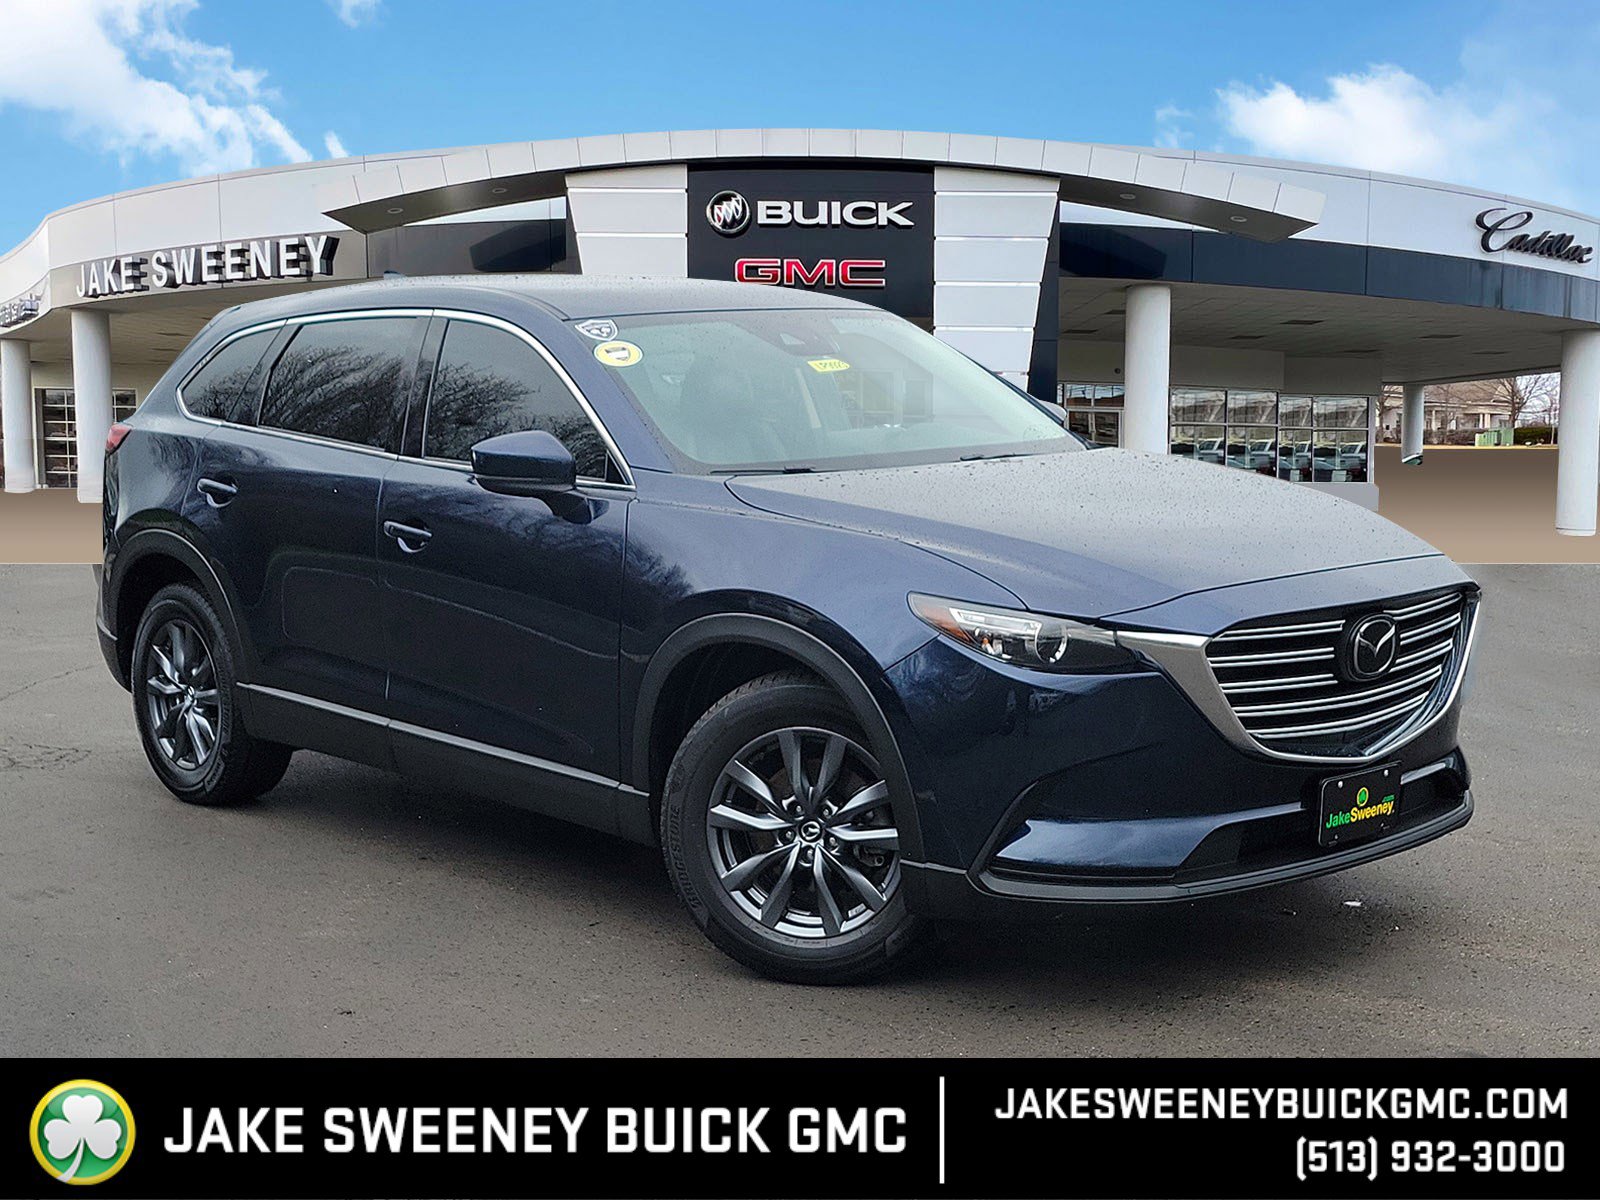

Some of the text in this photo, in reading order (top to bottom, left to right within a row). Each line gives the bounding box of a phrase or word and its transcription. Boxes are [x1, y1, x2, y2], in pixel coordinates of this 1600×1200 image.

[757, 201, 914, 226] BUICK
[1475, 207, 1593, 263] Cadillac
[76, 235, 332, 298] JAKE SWEENEY
[735, 258, 886, 287] GMC
[1326, 801, 1394, 829] JakeSweeney
[670, 804, 701, 908] BRIDGESTONE
